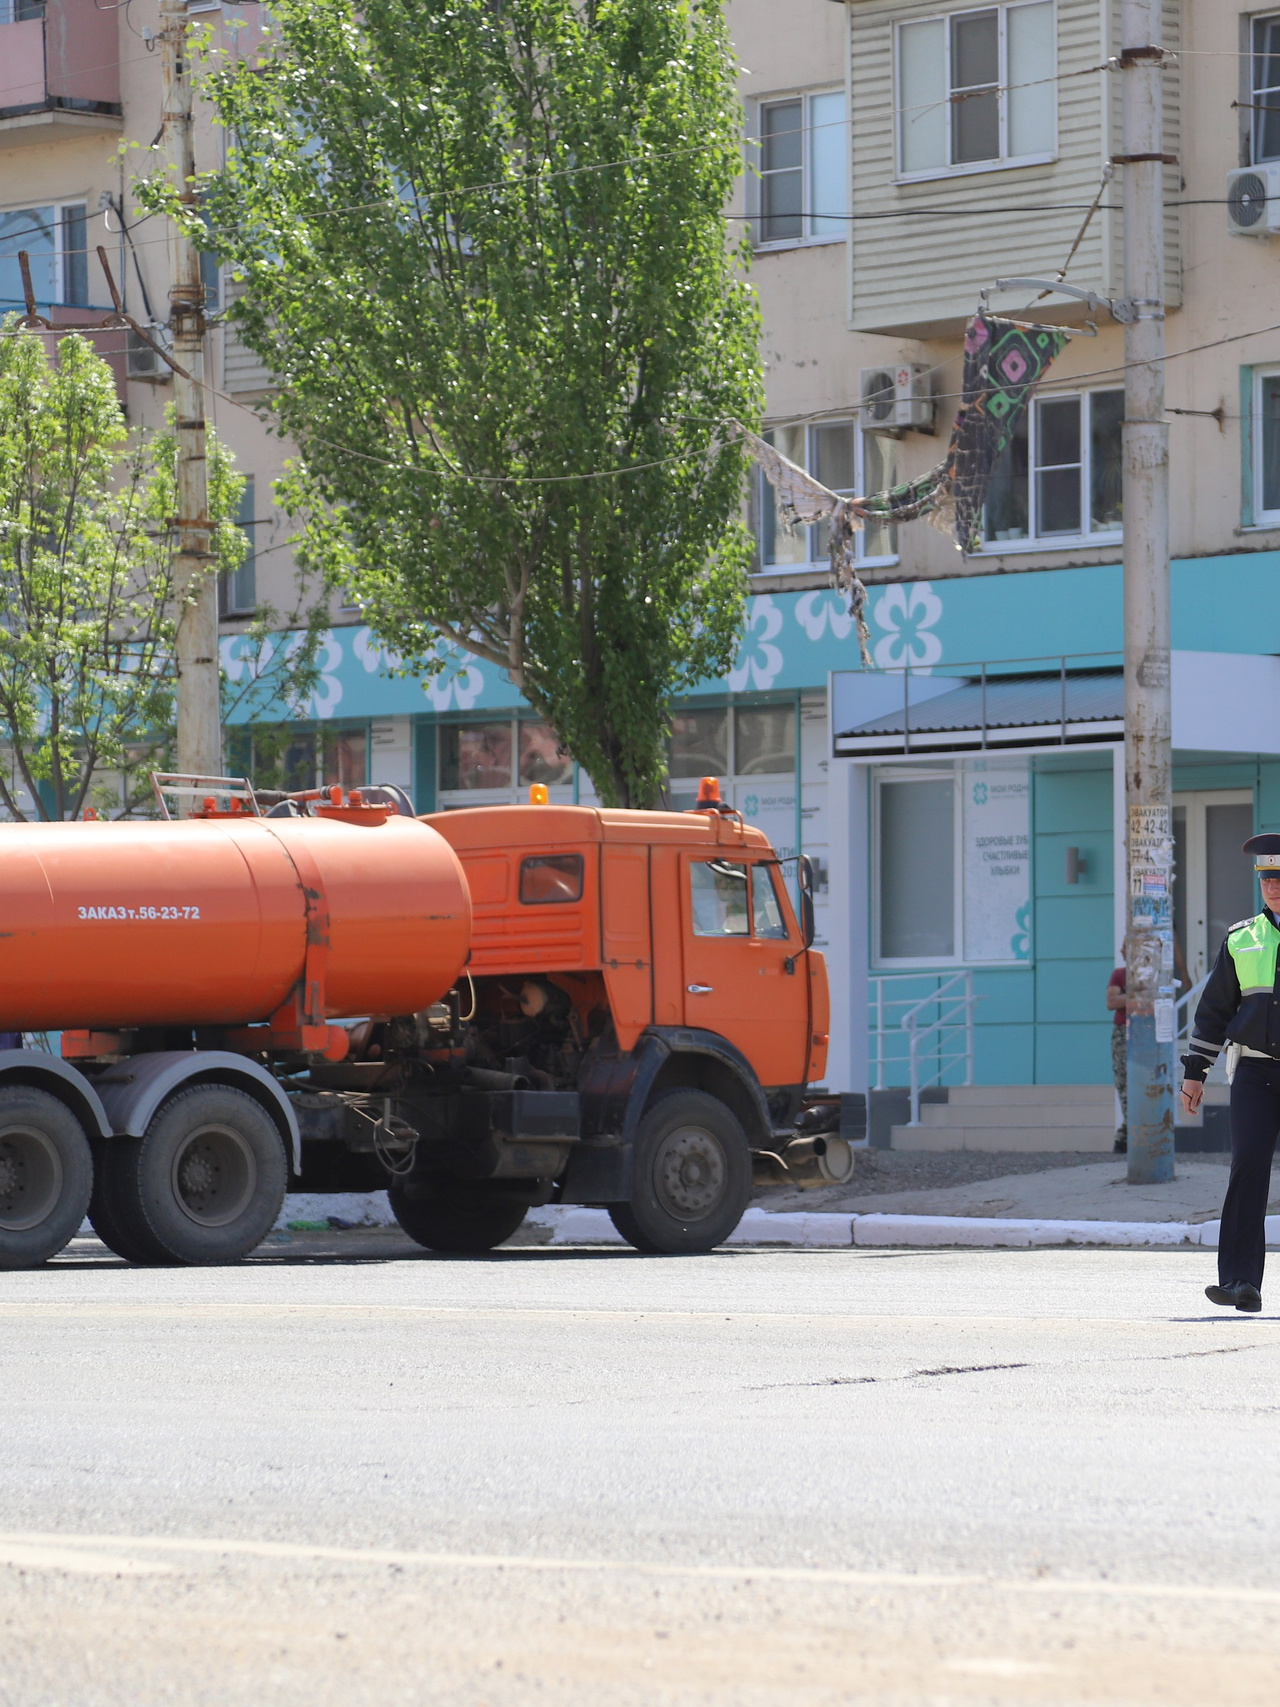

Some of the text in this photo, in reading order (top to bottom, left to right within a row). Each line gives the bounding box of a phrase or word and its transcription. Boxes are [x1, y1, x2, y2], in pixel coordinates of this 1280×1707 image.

[1131, 808, 1168, 818] ЭВАКУАТОР
[1131, 819, 1168, 834] 42-42-42
[976, 835, 1014, 847] ЗДОРОВЫЕ
[982, 850, 1028, 861] СЧАСТЛИВЫЕ
[990, 865, 1020, 876] УЛЫБКИ
[77, 906, 200, 919] ЗАКАЗ т.56-23-72
